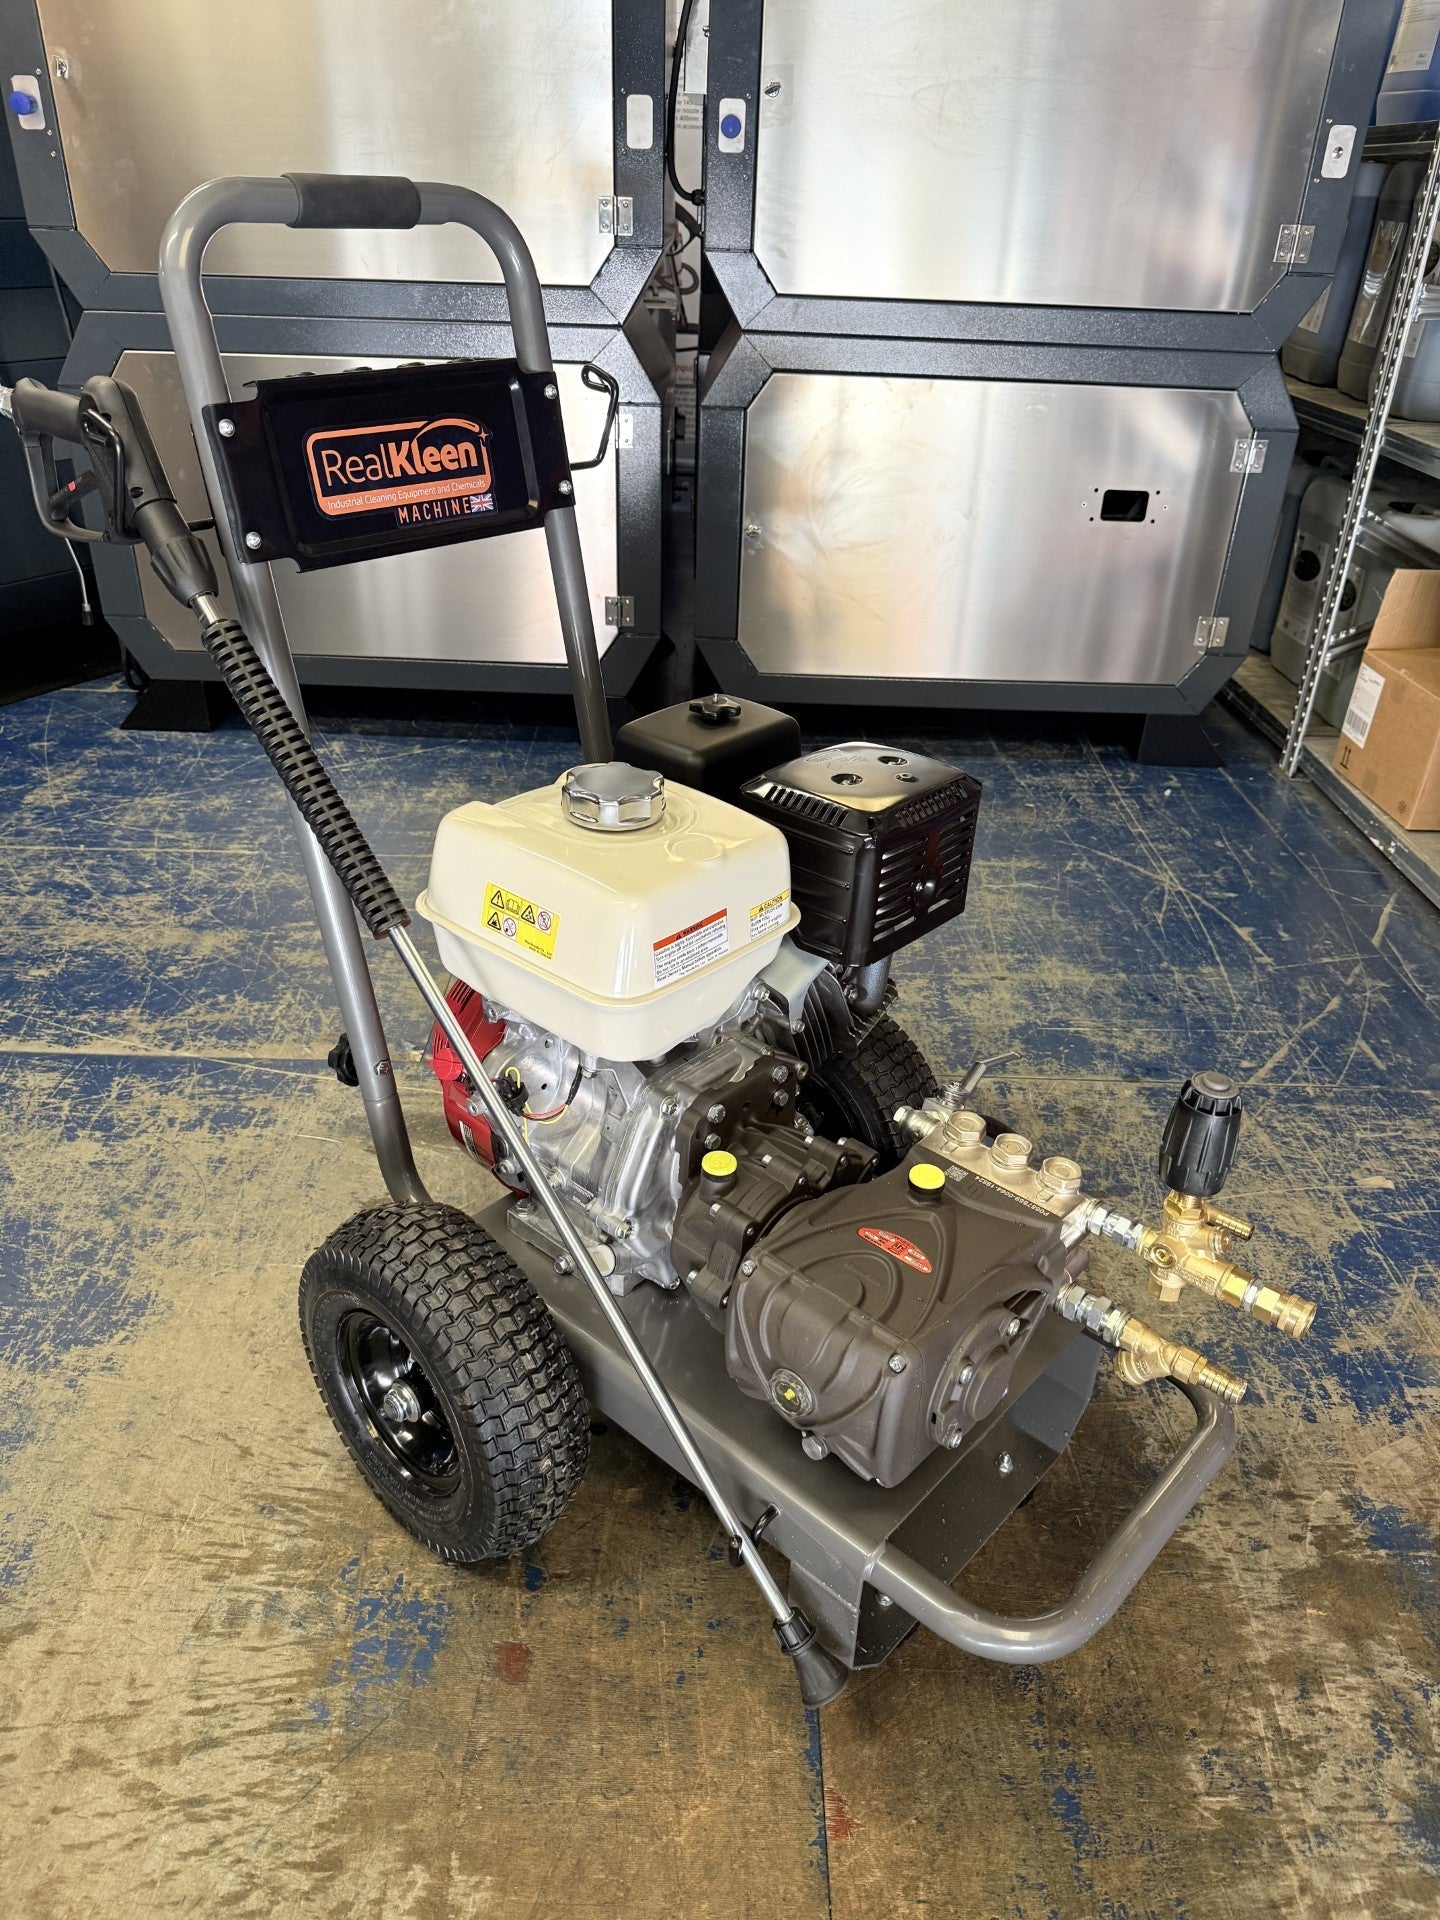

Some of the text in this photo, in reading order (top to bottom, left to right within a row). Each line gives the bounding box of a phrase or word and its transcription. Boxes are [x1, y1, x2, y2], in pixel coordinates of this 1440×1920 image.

[321, 439, 478, 487] RealKleen
[328, 480, 486, 510] Industrial Cleaning Equipment and Chemicals
[399, 497, 471, 524] MACHINE
